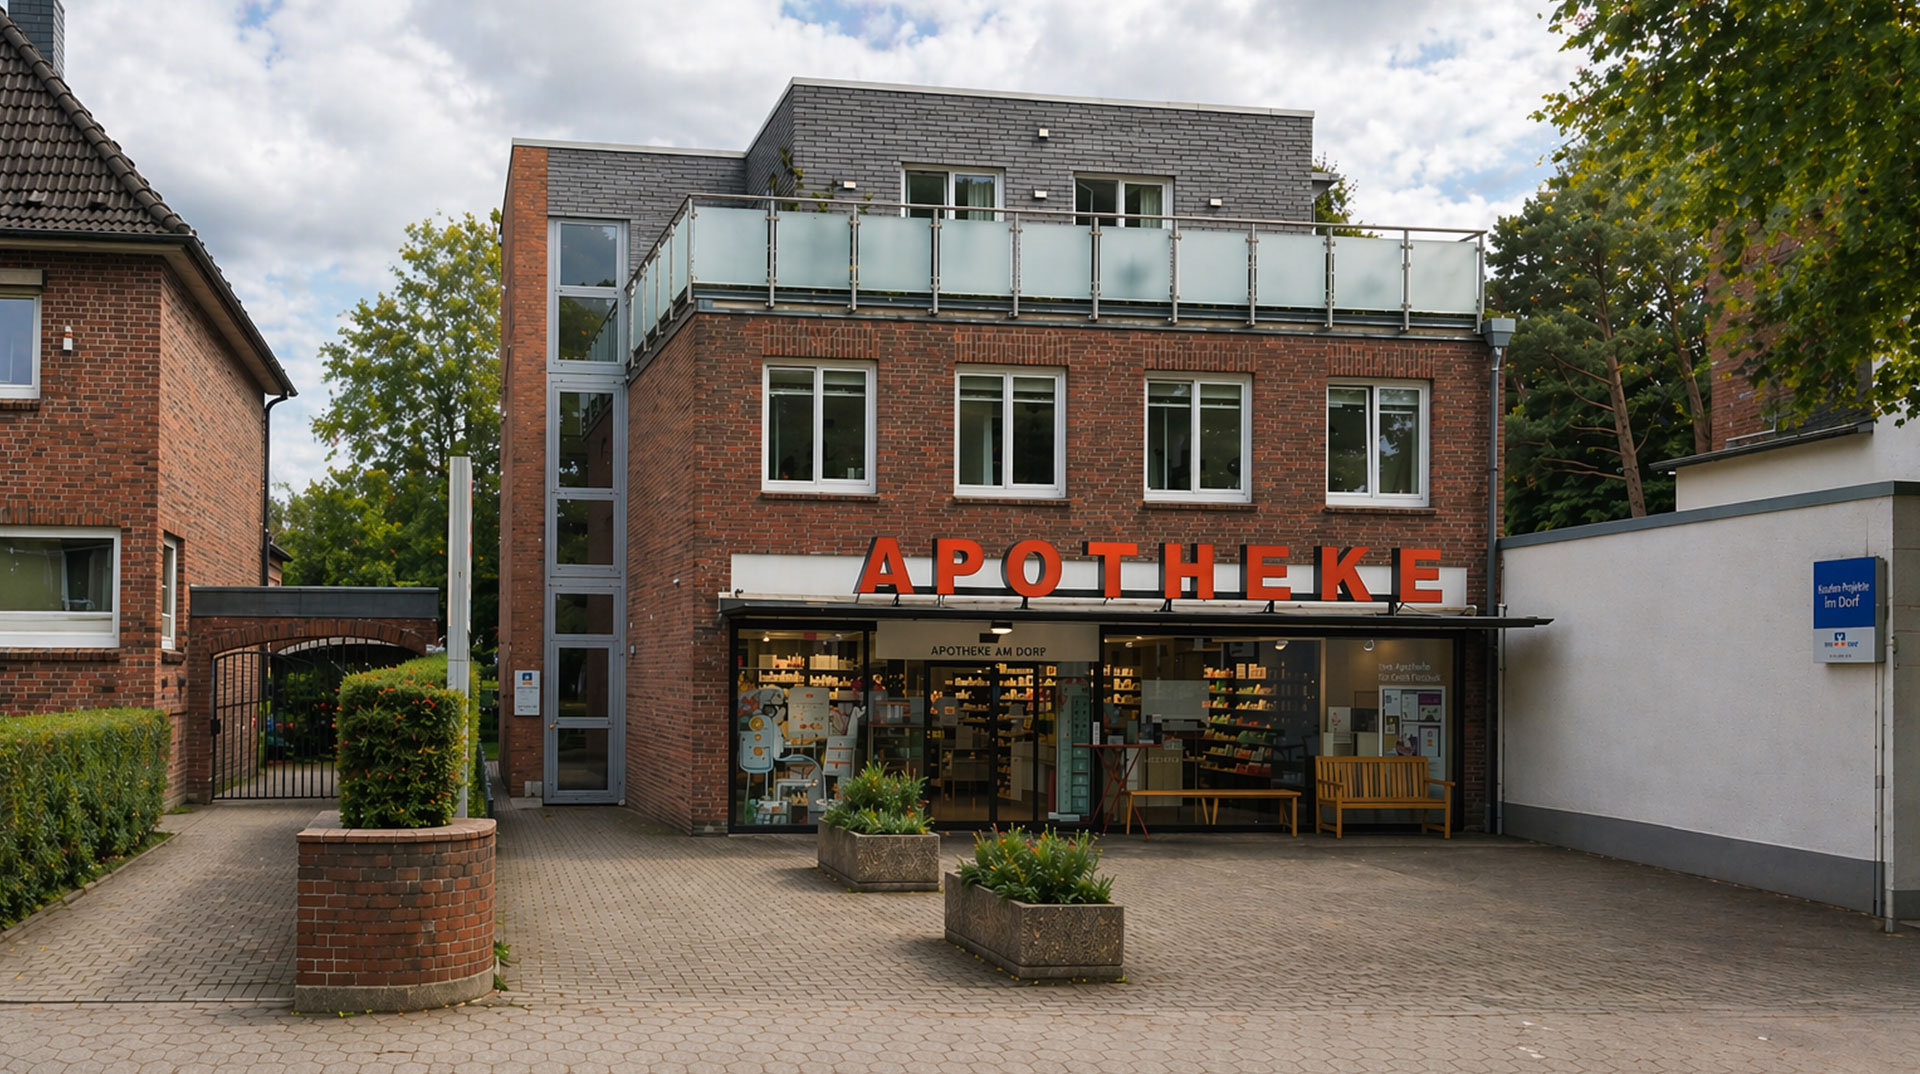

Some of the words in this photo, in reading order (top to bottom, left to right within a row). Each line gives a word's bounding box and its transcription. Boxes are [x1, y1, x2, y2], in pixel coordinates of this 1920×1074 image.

[856, 536, 1444, 603] APOTHEKE
[1838, 593, 1860, 608] Dorf
[931, 645, 991, 656] APOTHEKE
[995, 647, 1012, 656] AM
